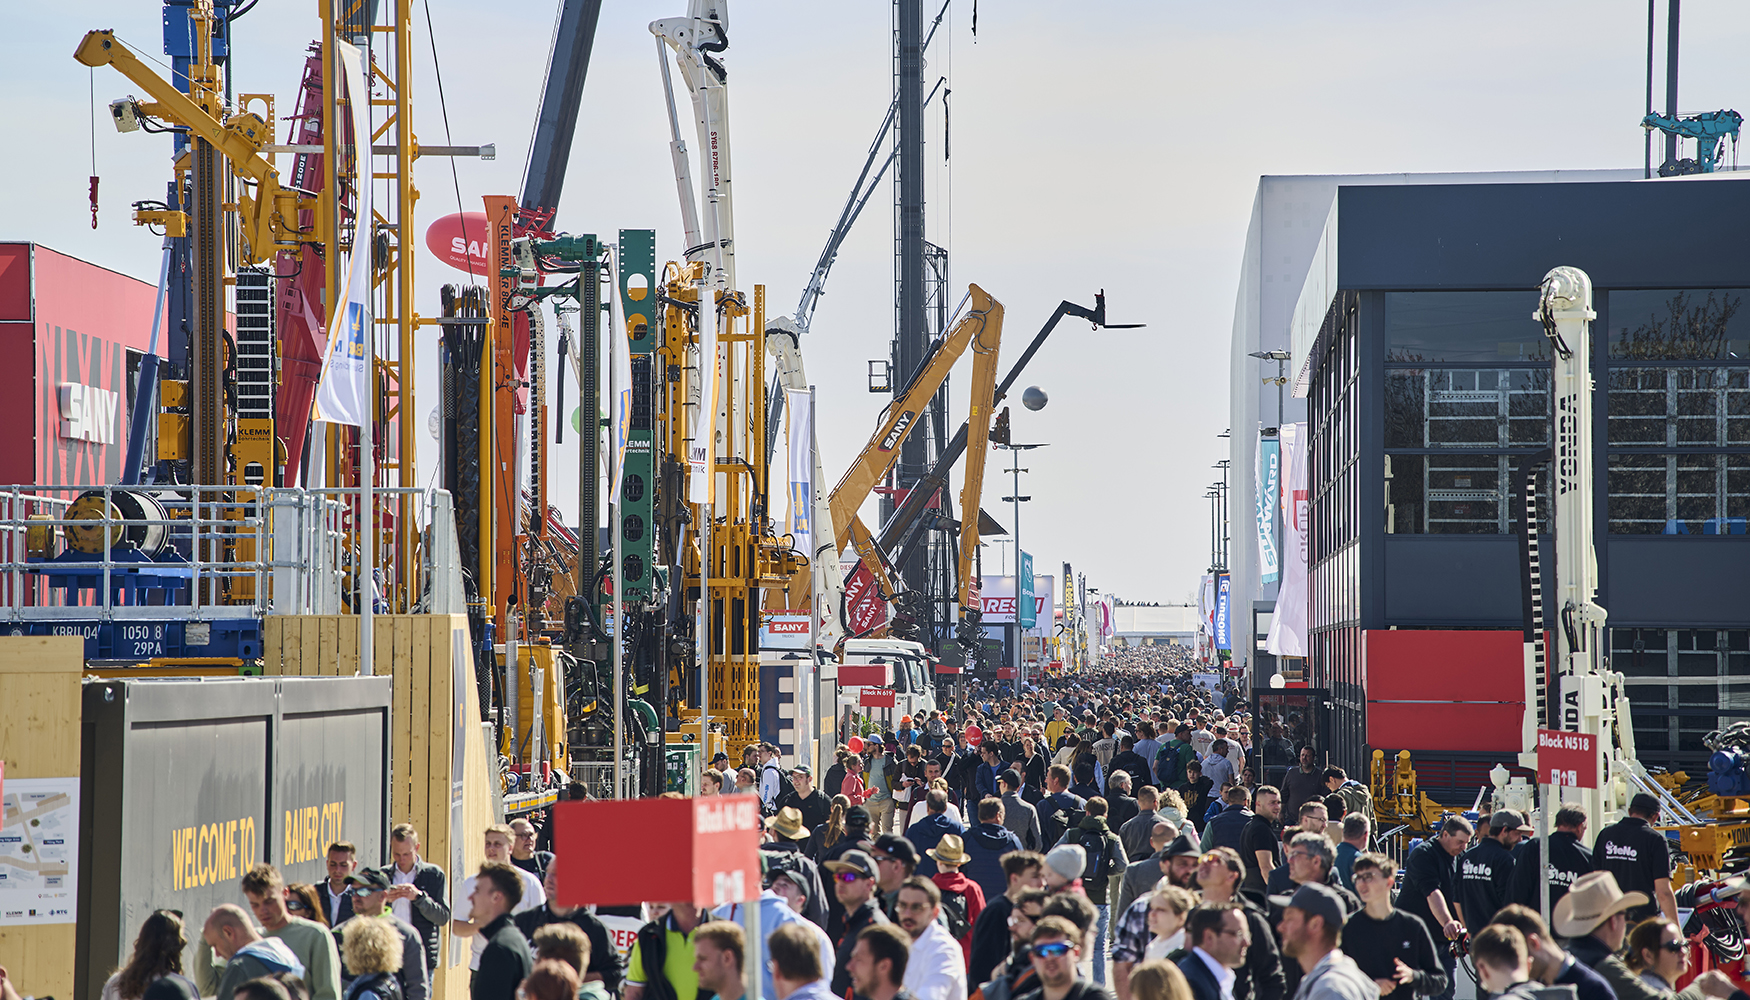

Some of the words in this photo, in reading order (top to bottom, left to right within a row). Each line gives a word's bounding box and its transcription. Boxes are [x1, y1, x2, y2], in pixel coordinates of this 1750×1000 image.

[501, 225, 509, 268] KLEMM
[61, 382, 118, 444] SANY
[884, 413, 910, 449] SANY
[1560, 393, 1578, 495] YONDA
[84, 626, 98, 639] 04
[122, 626, 149, 639] 1050
[154, 626, 162, 640] 8
[861, 604, 877, 628] SANY
[134, 642, 162, 655] 29PA
[1540, 733, 1563, 748] Block
[1565, 736, 1589, 751] N518
[285, 806, 319, 865] BAUER
[321, 801, 344, 858] CITY
[173, 819, 237, 891] WELCOME
[240, 816, 255, 877] TO
